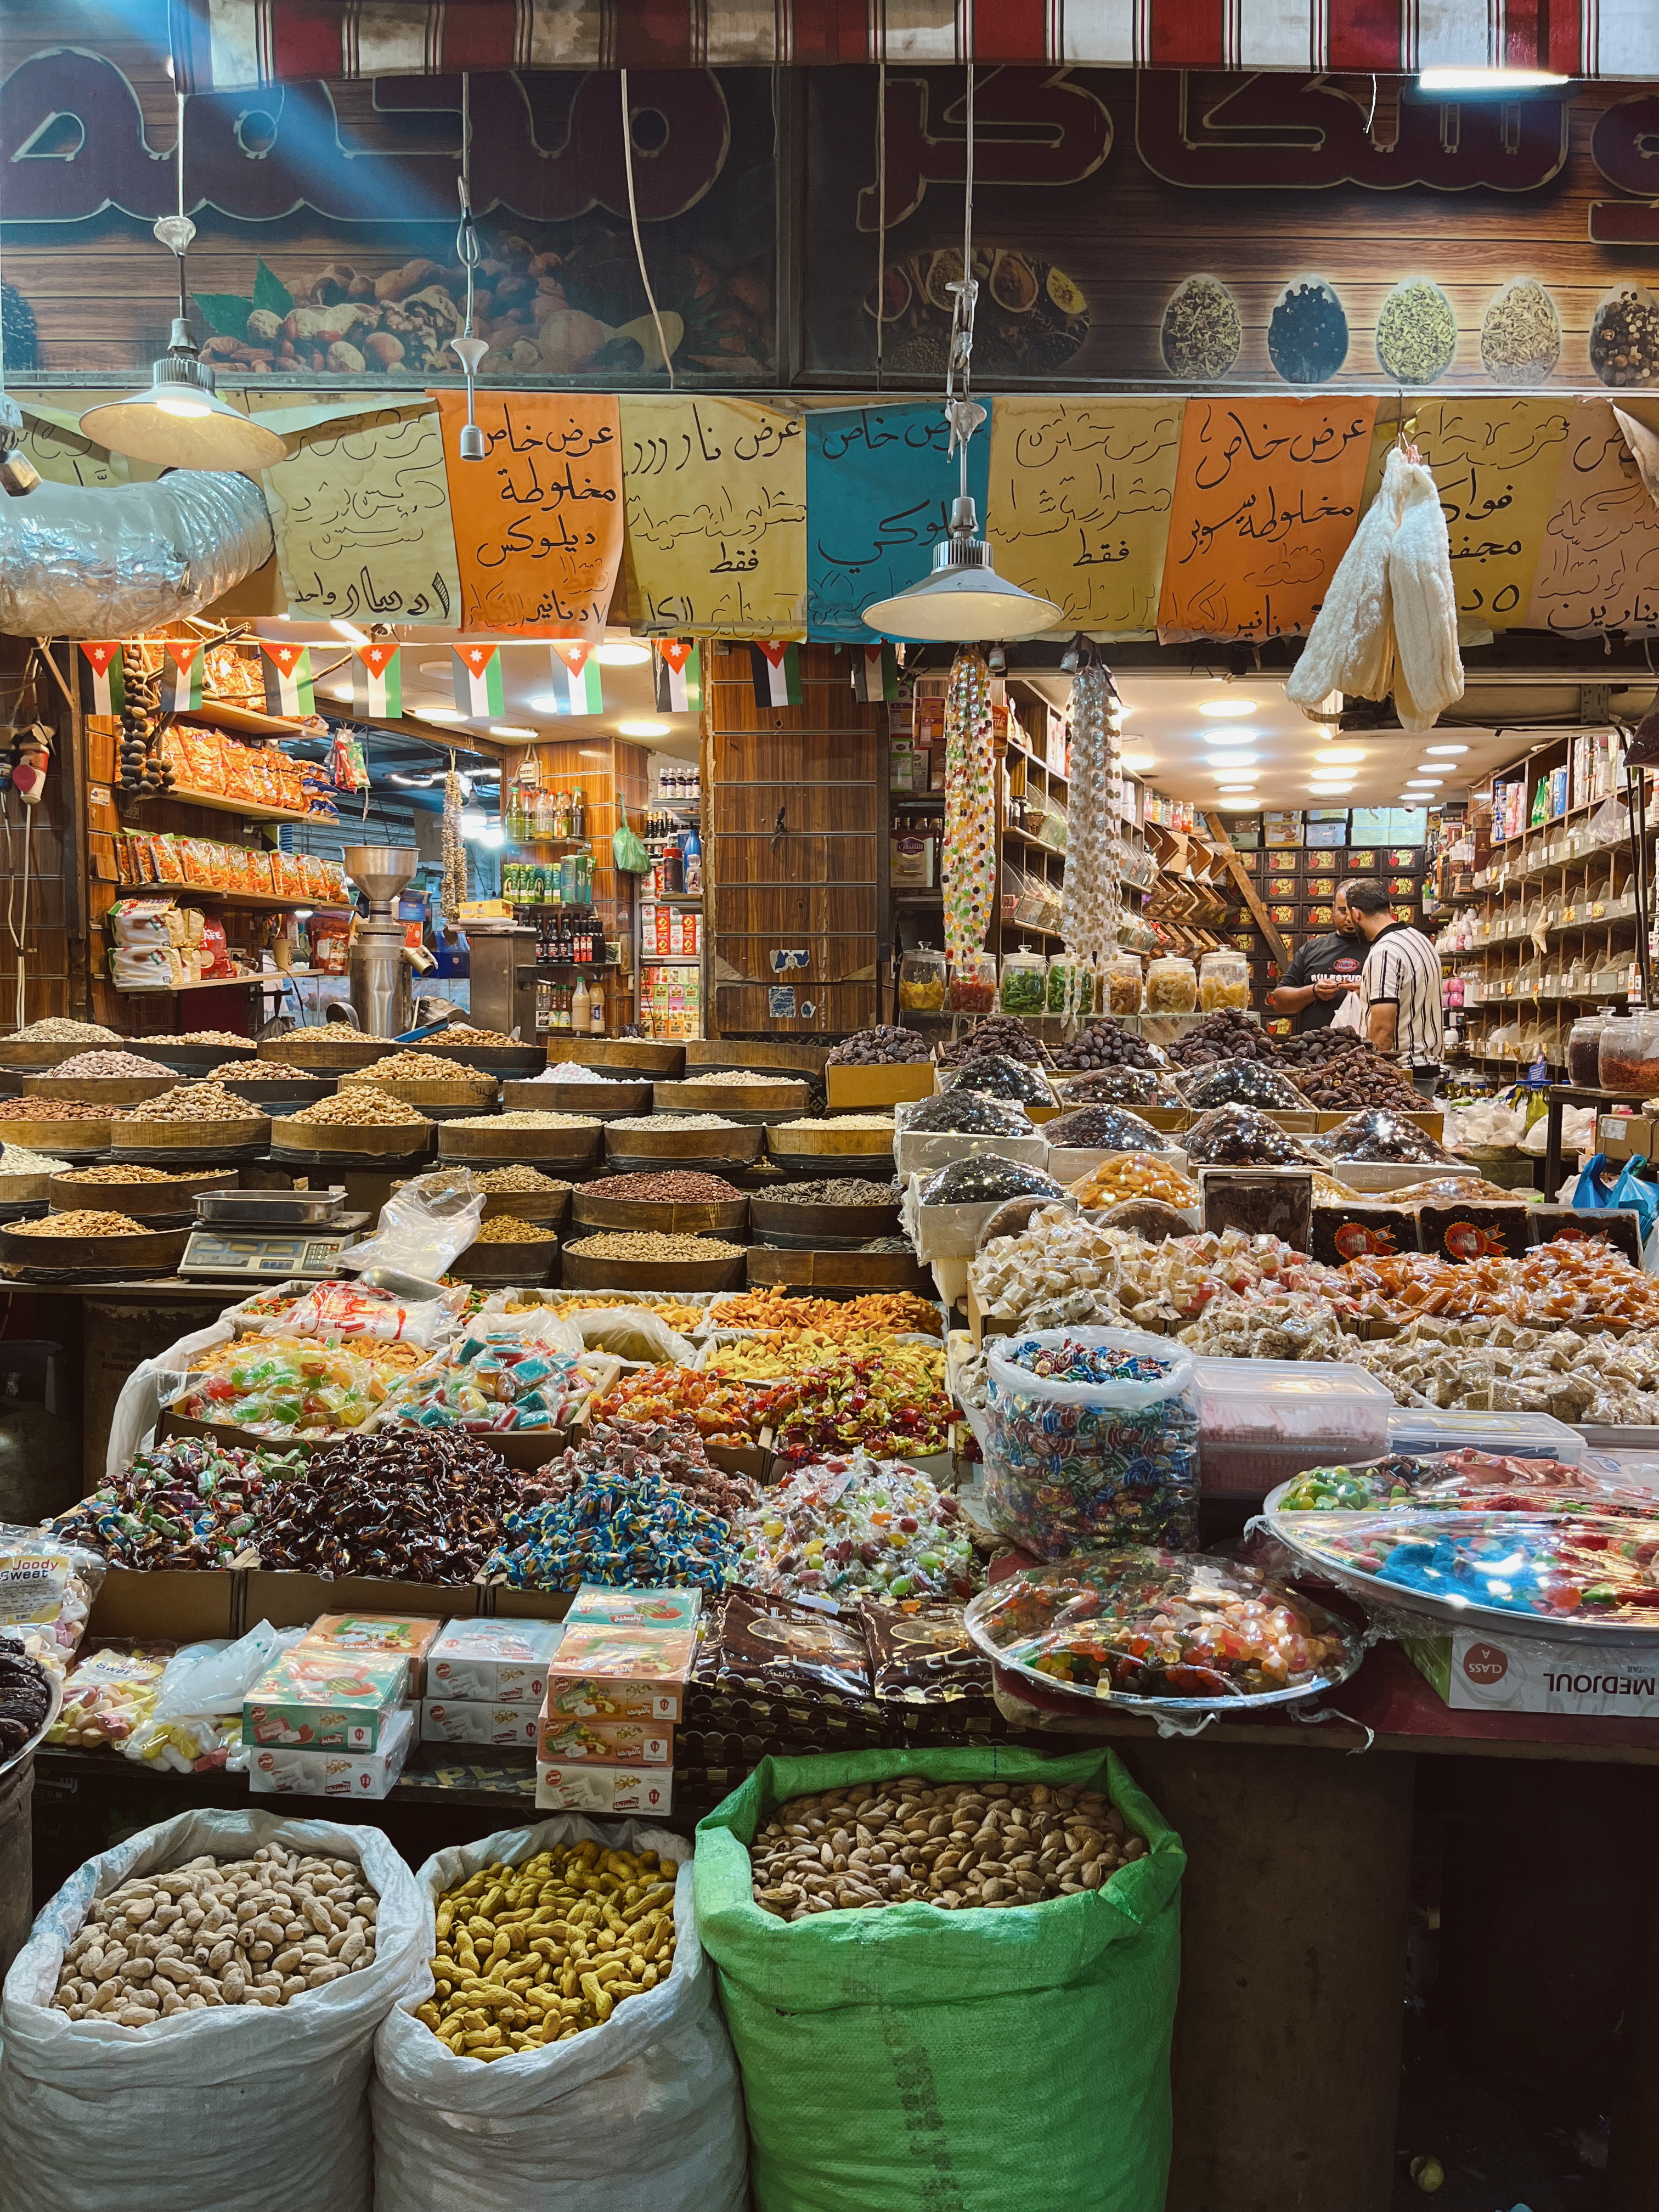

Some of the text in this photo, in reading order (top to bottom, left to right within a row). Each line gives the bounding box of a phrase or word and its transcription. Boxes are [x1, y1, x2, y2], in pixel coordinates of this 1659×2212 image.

[484, 403, 543, 457] خاص
[546, 418, 613, 457] عرض
[734, 418, 802, 460] عرض
[823, 408, 899, 460] خاص
[1195, 411, 1290, 489] خاص
[1289, 417, 1367, 464] عرض
[497, 456, 616, 511] مخلوطة
[1437, 467, 1514, 523] فواك
[817, 499, 955, 574] لوكي
[1238, 486, 1355, 543] مخلوطة
[477, 515, 596, 567] ديلوكس
[710, 541, 759, 574] فقط
[1073, 528, 1130, 567] فقط
[0, 1569, 49, 1582] Sweet
[13, 1559, 59, 1571] Joody
[1469, 1663, 1502, 1674] CLASS
[1481, 1650, 1491, 1659] A
[1543, 1673, 1656, 1696] MEDJOUL
